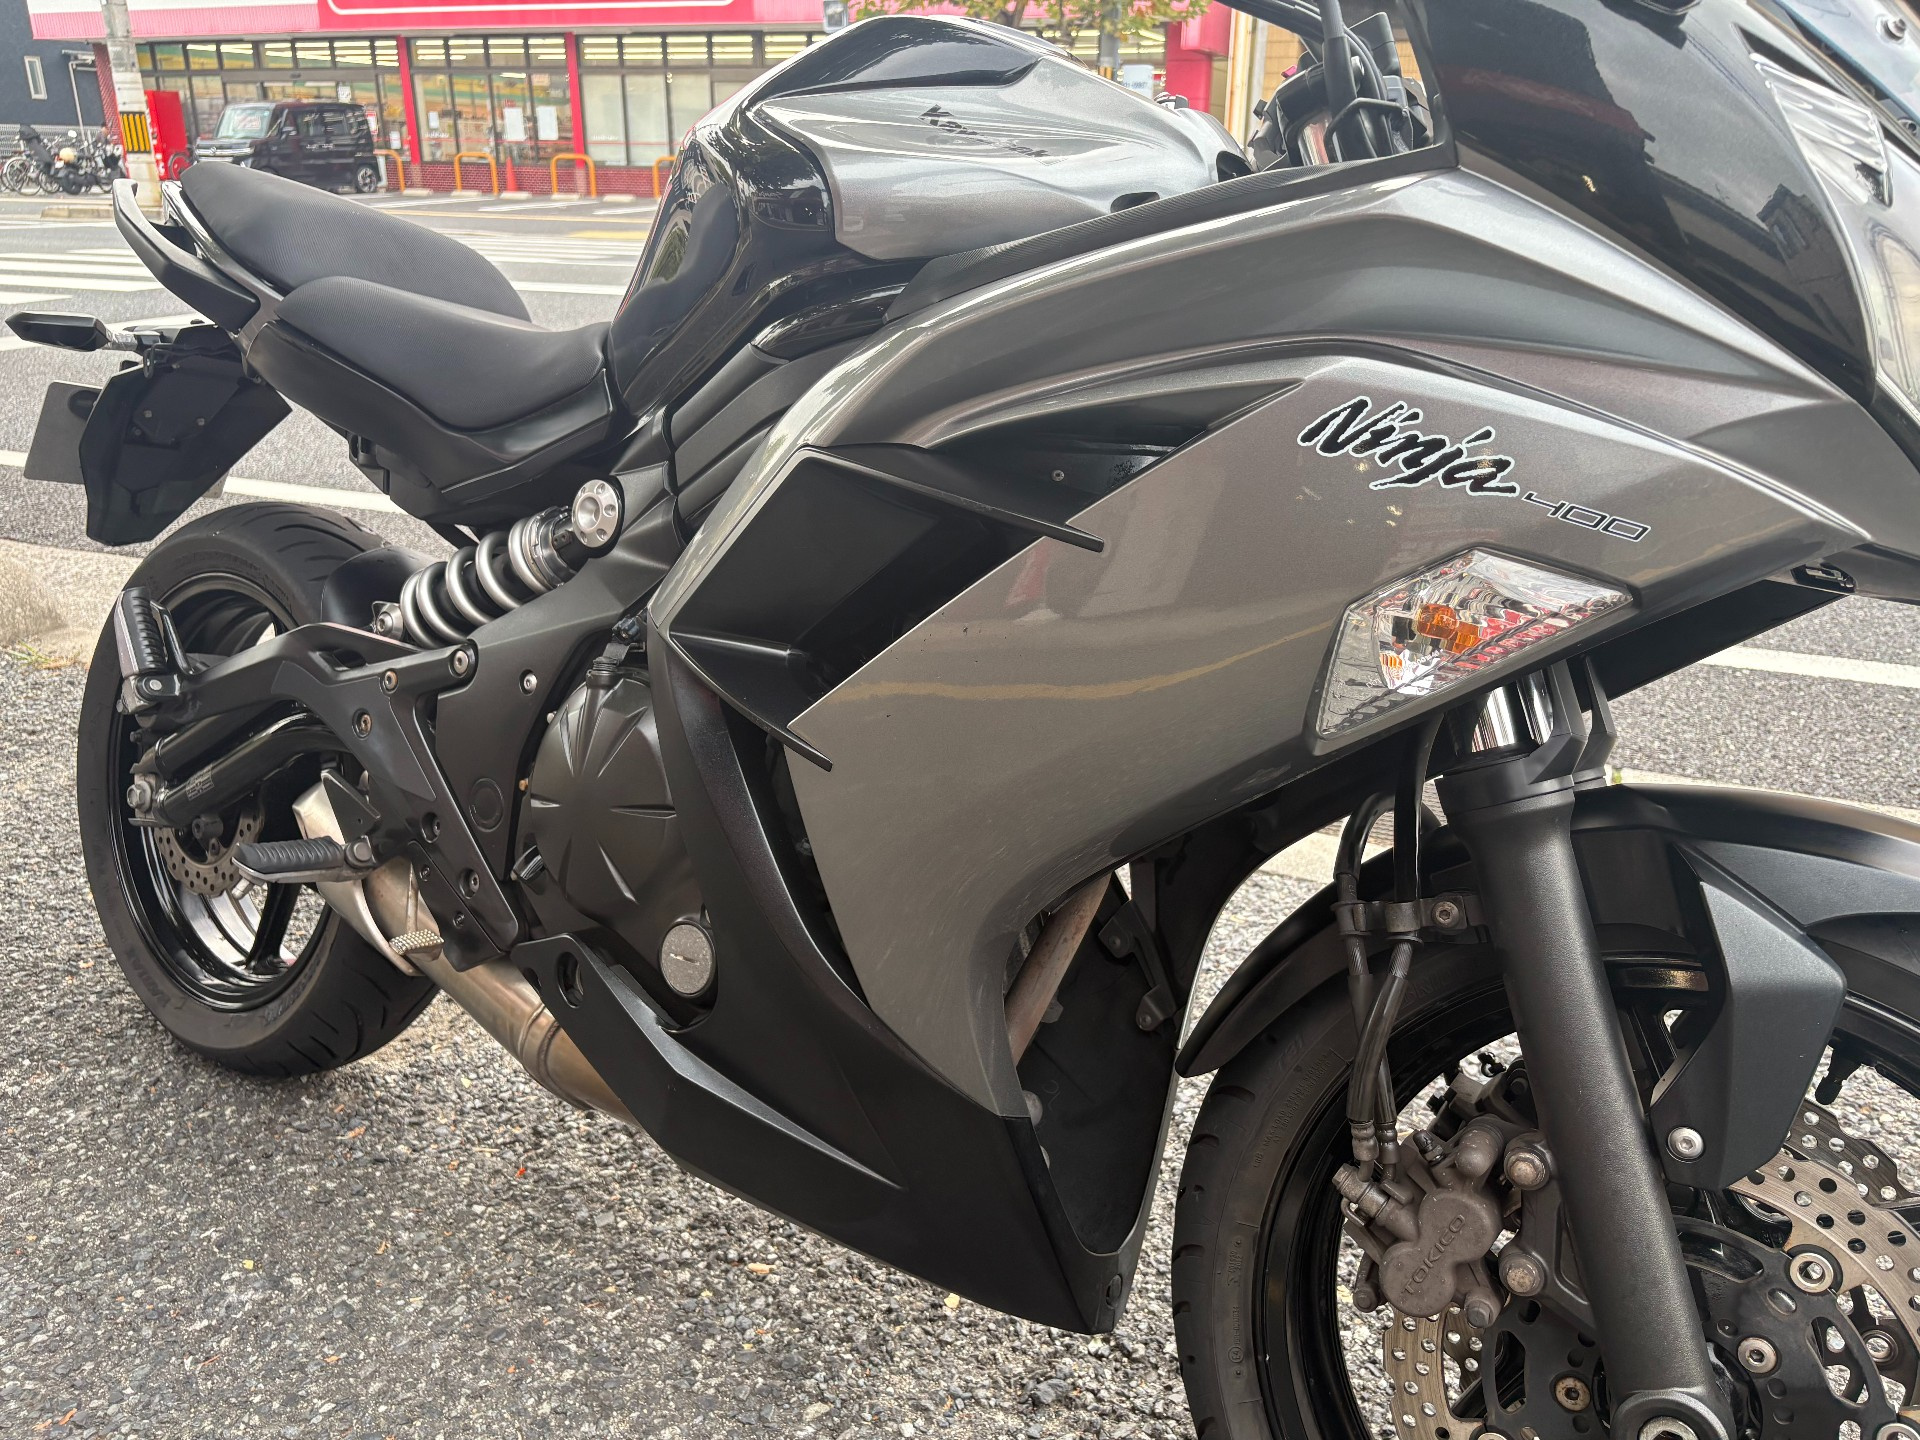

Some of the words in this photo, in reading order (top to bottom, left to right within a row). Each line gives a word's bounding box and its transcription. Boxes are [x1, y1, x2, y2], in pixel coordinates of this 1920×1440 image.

[917, 103, 1069, 166] Kawak
[1297, 396, 1520, 497] Ninja
[1522, 491, 1652, 542] 400
[1401, 1214, 1466, 1296] TOKICO
